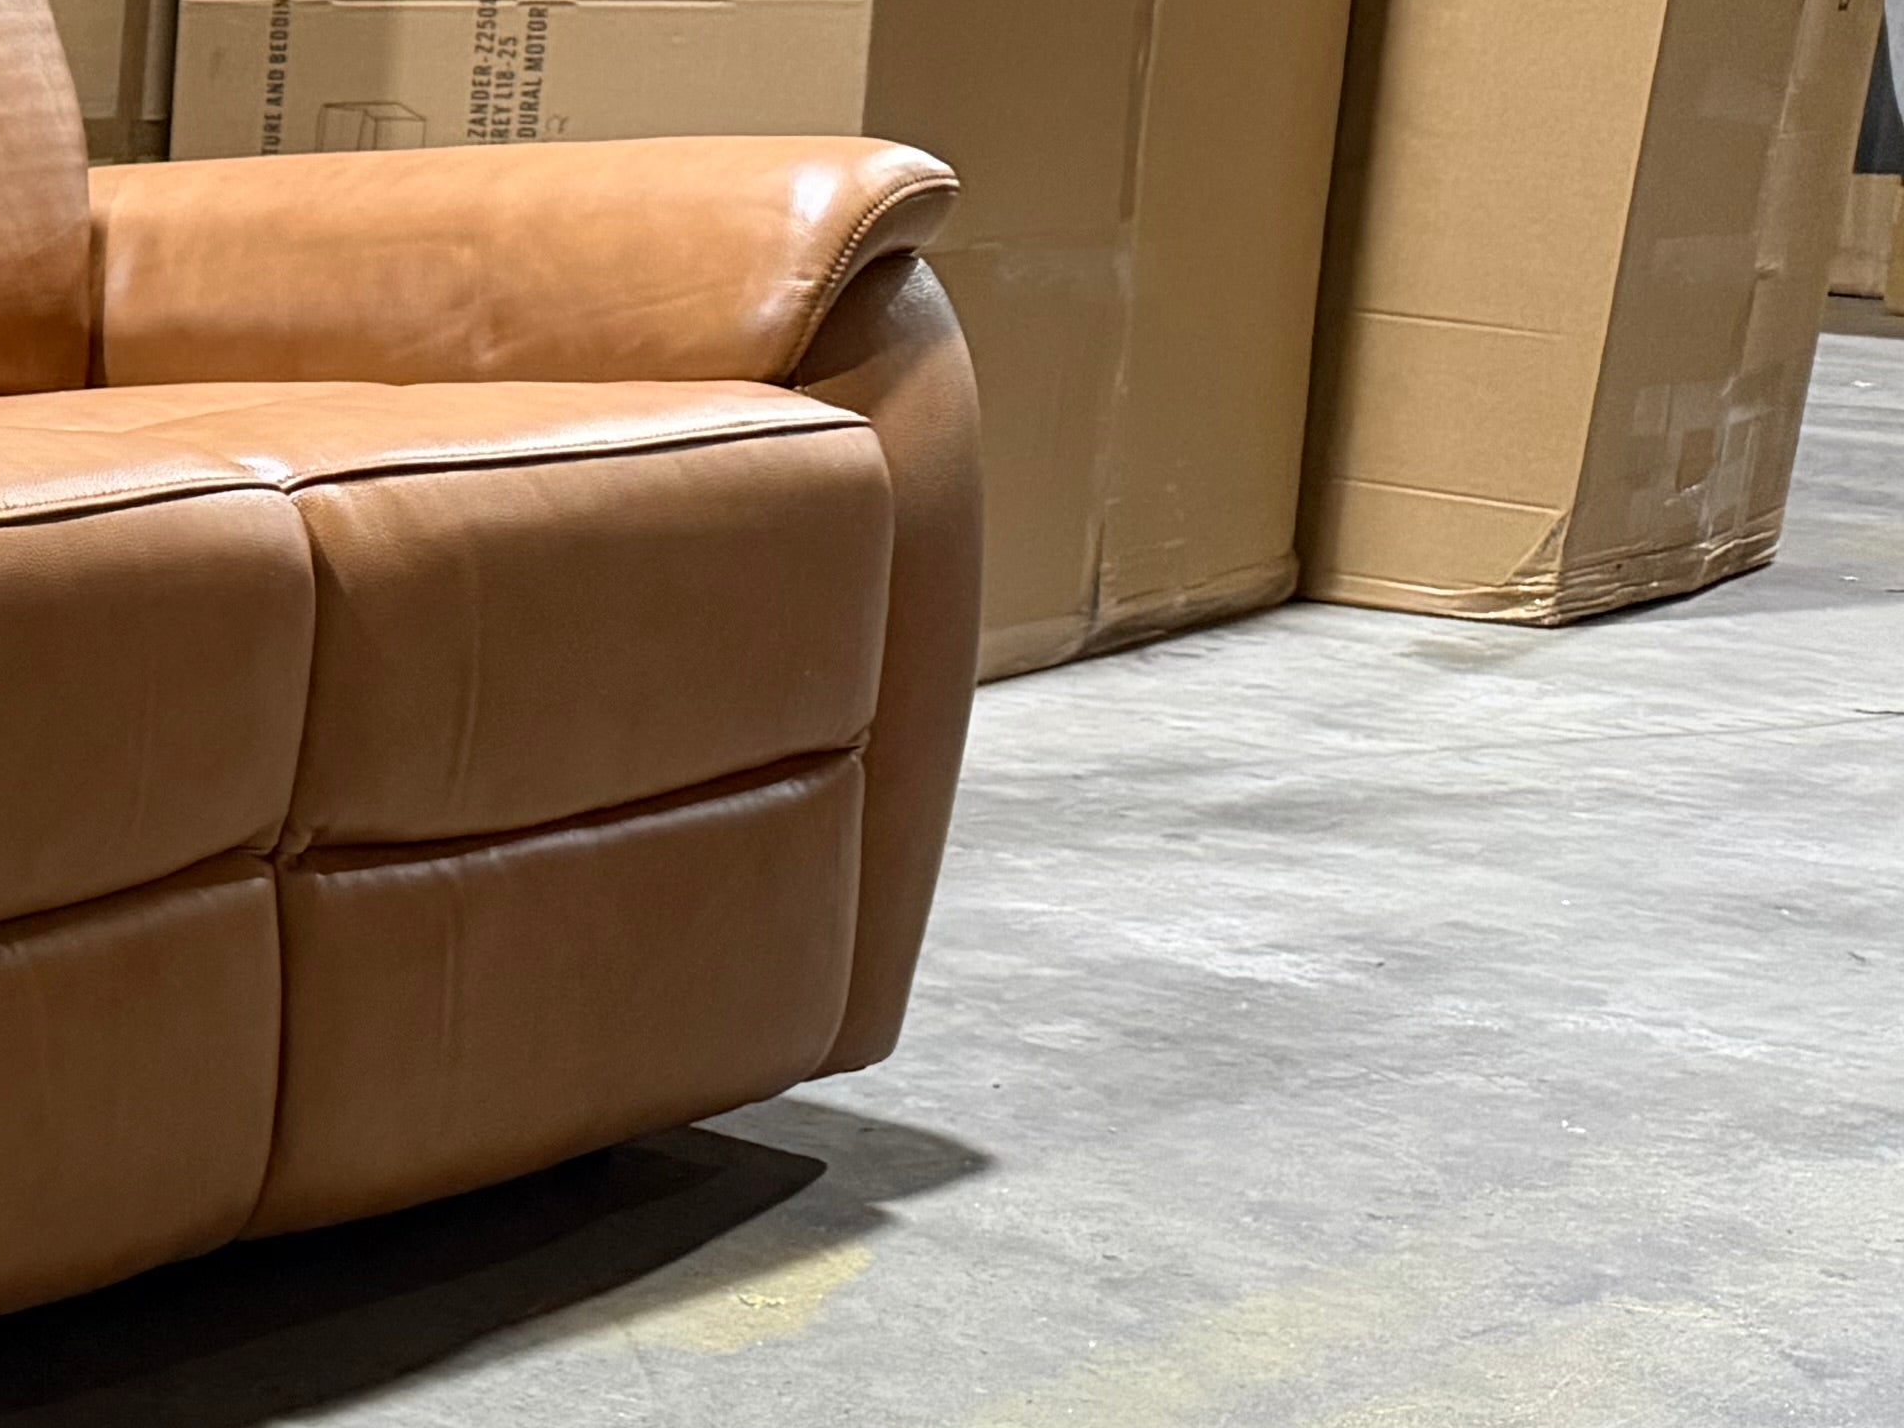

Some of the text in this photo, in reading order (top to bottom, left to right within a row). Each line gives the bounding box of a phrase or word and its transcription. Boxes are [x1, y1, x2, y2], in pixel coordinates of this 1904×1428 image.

[265, 70, 286, 110] AND
[494, 35, 519, 100] L18-25
[515, 5, 551, 139] DURAL MOTOR
